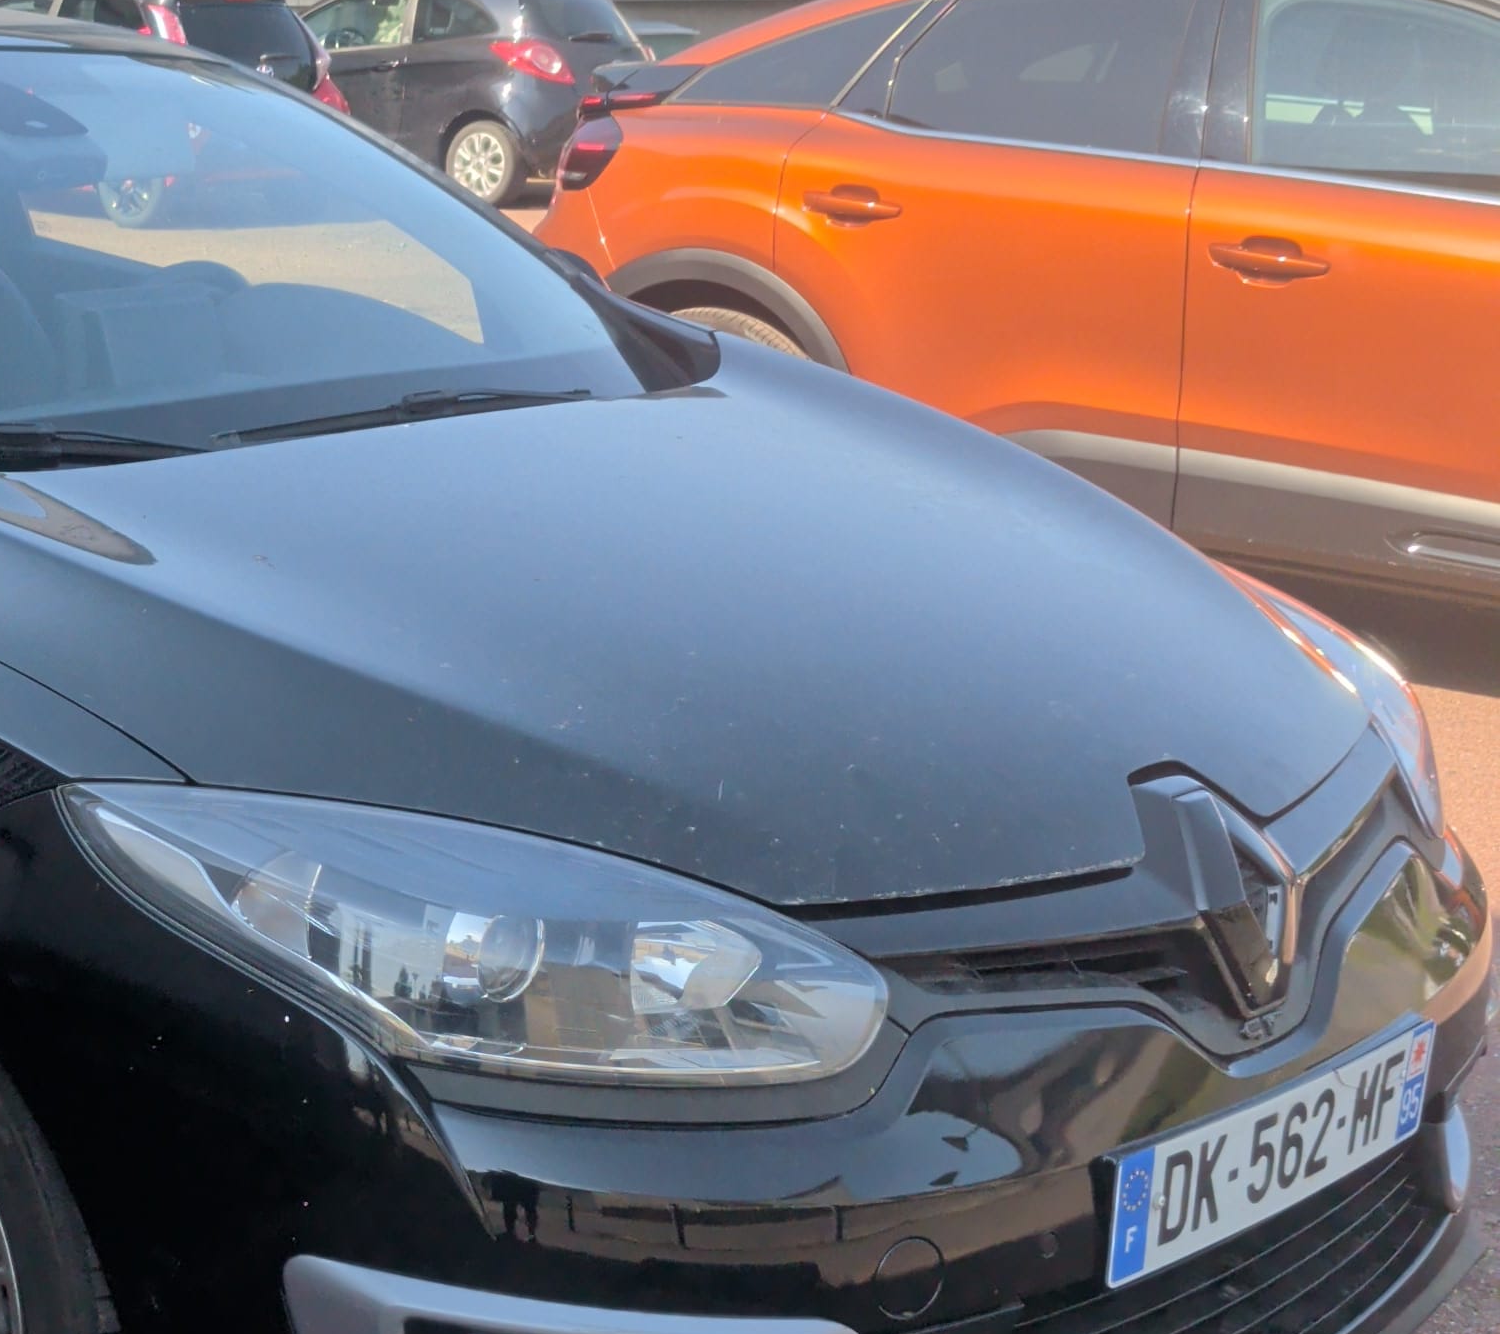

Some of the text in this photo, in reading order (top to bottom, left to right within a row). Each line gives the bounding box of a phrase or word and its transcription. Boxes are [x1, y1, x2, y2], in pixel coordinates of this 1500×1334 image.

[1400, 1082, 1422, 1125] 95
[1157, 1049, 1406, 1247] DK-562-MF
[1124, 1225, 1138, 1254] F
